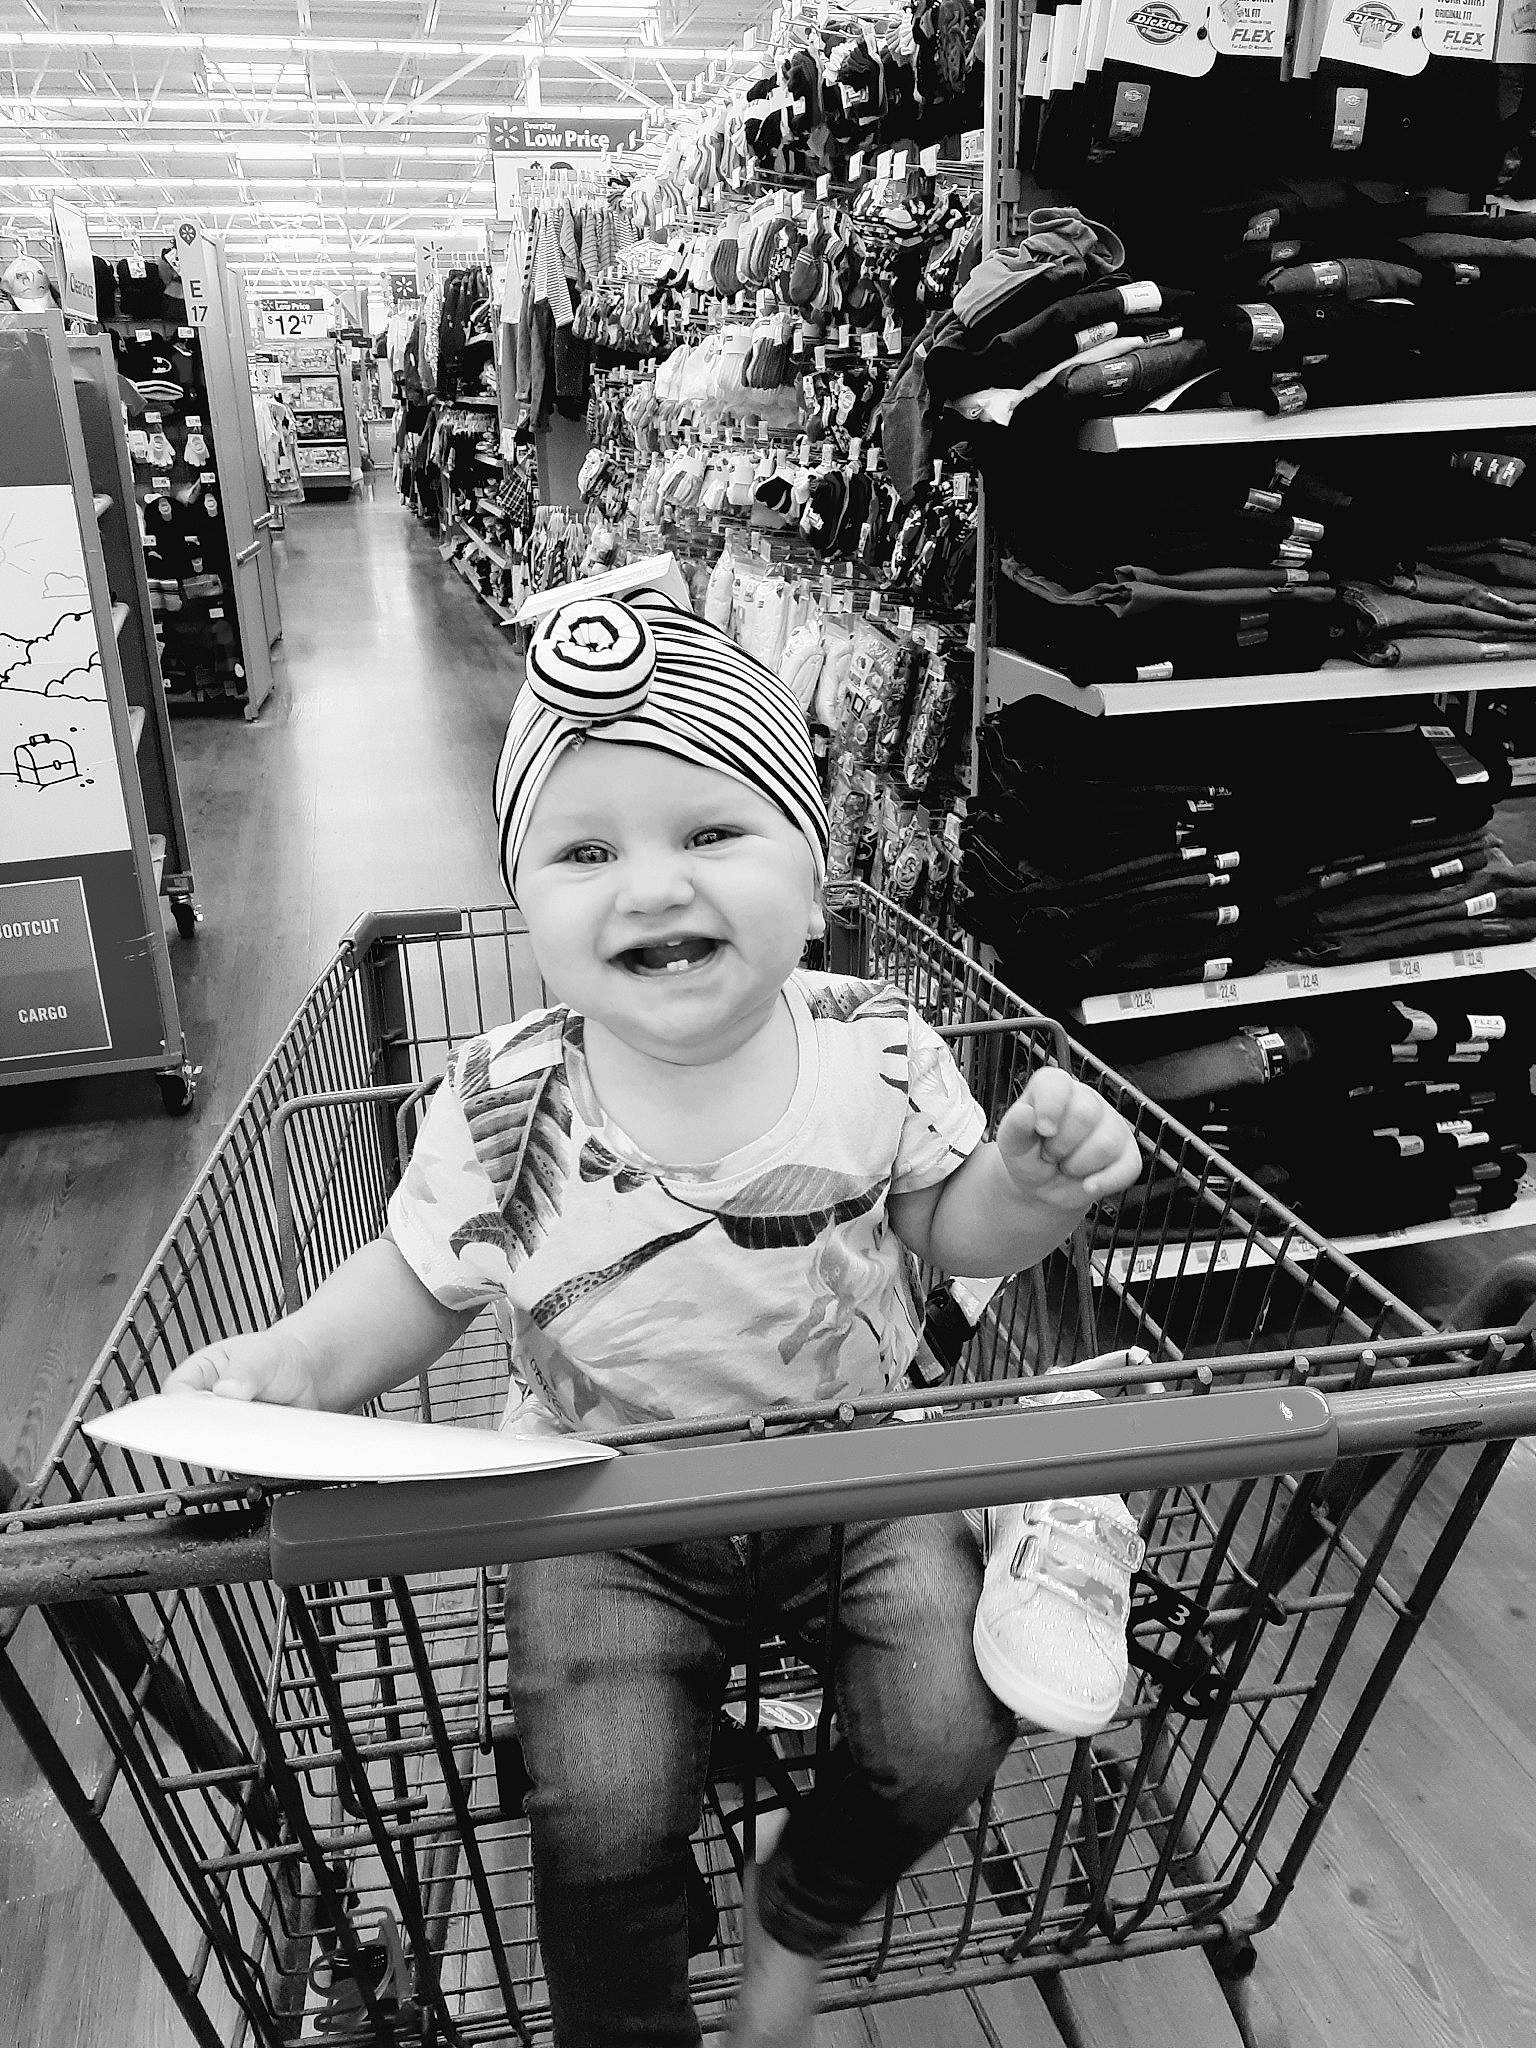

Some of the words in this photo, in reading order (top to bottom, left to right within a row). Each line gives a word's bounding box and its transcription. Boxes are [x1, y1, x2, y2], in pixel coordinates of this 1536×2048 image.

[1133, 13, 1184, 33] Dickies
[1230, 28, 1276, 43] FLEX
[1442, 30, 1486, 46] FLEX
[523, 121, 557, 131] Everyday
[524, 129, 562, 147] Low
[564, 129, 611, 148] Price
[189, 280, 203, 298] E
[191, 305, 208, 322] 17
[0, 918, 60, 939] OOTCUT
[18, 1005, 68, 1023] CARGO
